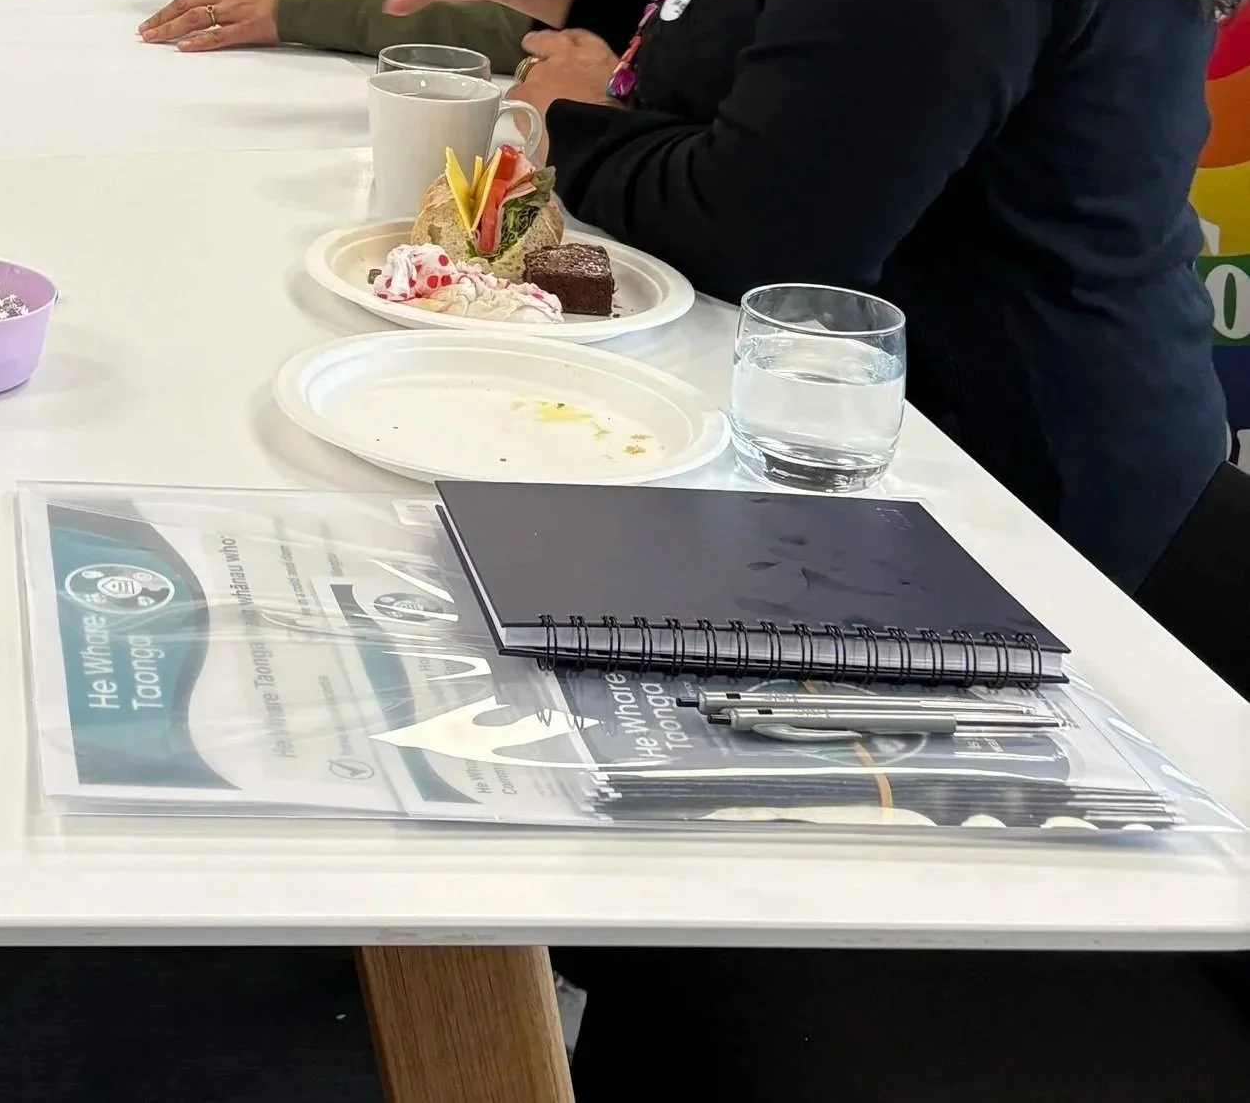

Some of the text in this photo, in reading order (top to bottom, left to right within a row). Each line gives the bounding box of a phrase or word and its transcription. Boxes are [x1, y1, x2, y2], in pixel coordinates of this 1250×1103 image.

[79, 612, 120, 709] He Whare
[127, 634, 166, 710] Taonga
[603, 672, 667, 759] He Whare
[639, 682, 692, 751] Taonga
